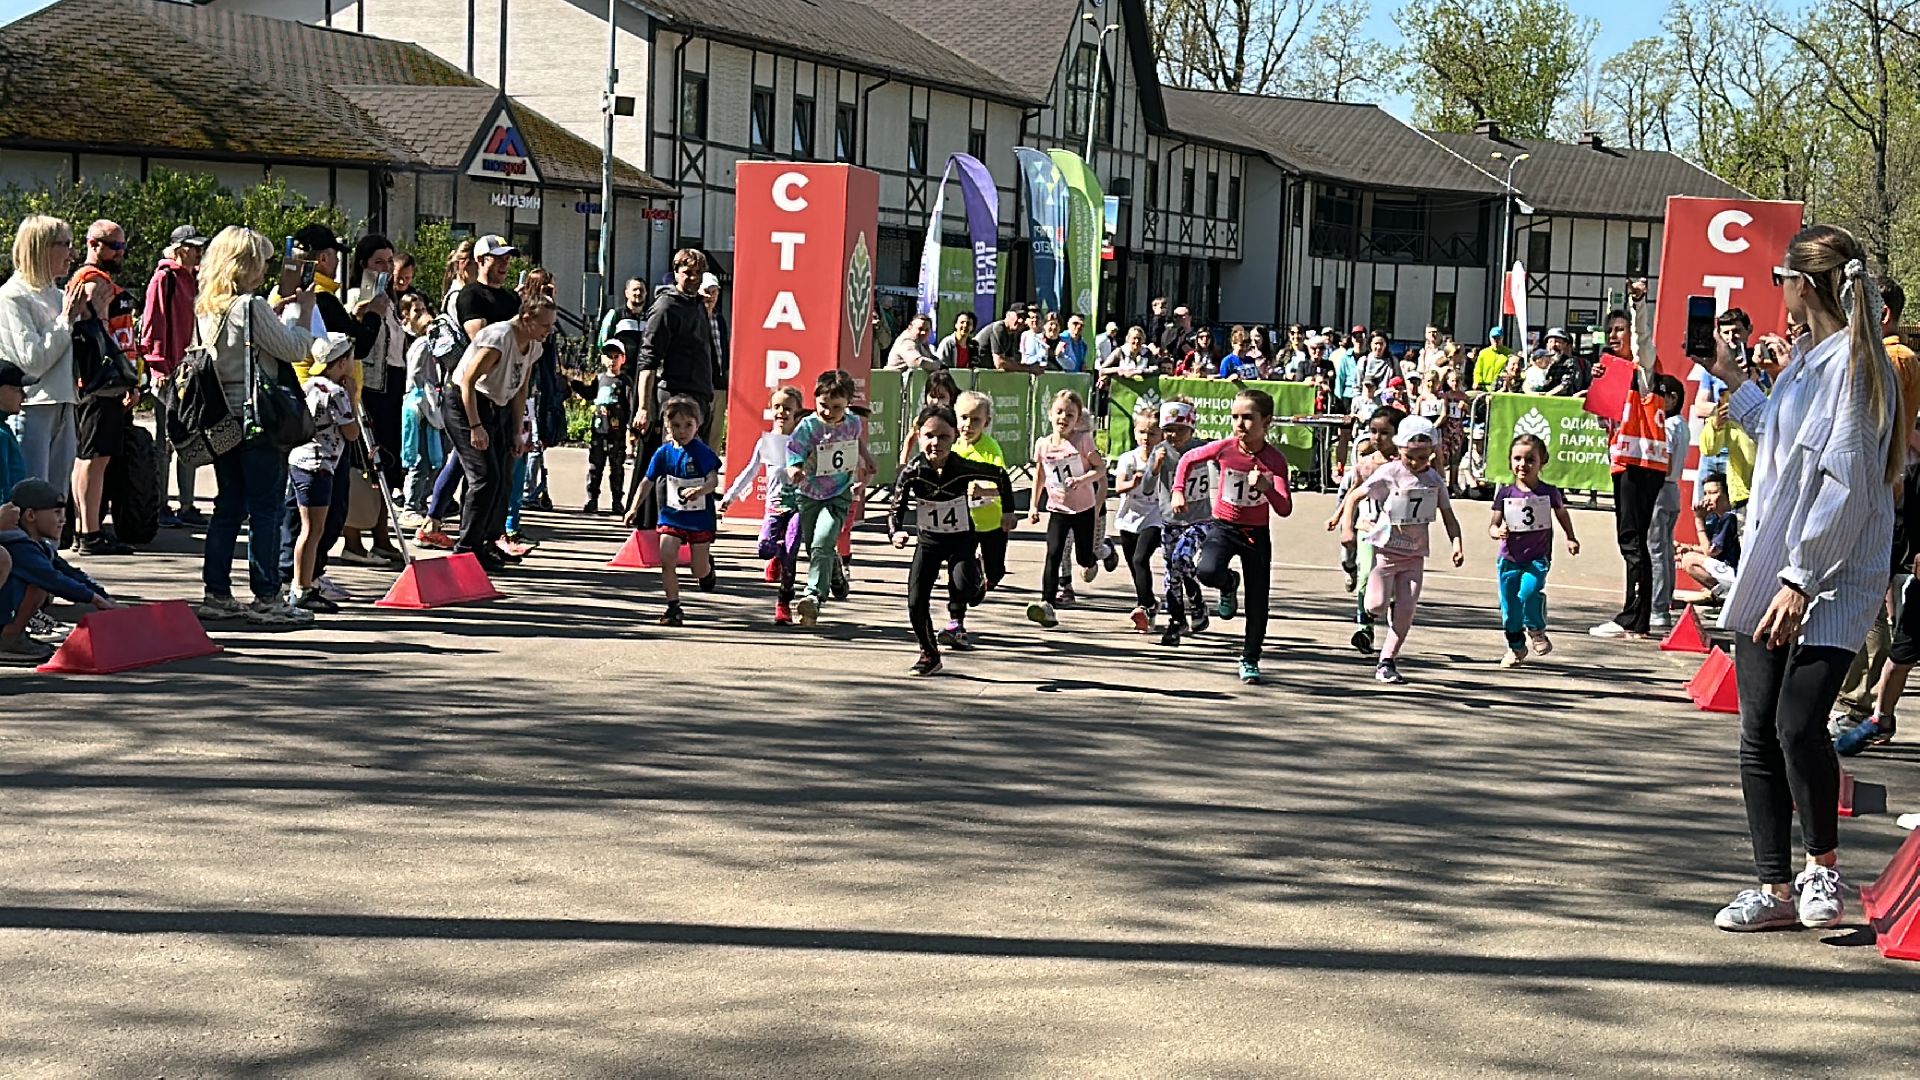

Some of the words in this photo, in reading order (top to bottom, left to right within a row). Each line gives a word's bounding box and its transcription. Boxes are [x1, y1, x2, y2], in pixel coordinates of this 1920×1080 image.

[491, 192, 541, 208] МАГАЗИН
[762, 171, 811, 421] СТАР
[1560, 416, 1606, 431] ОДИН
[1560, 432, 1594, 447] ПАРК
[832, 450, 844, 469] 6
[1557, 450, 1610, 465] СПОРТА
[1053, 464, 1072, 483] 11
[927, 506, 959, 527] 14
[1409, 497, 1423, 518] 7
[1521, 505, 1536, 526] 3
